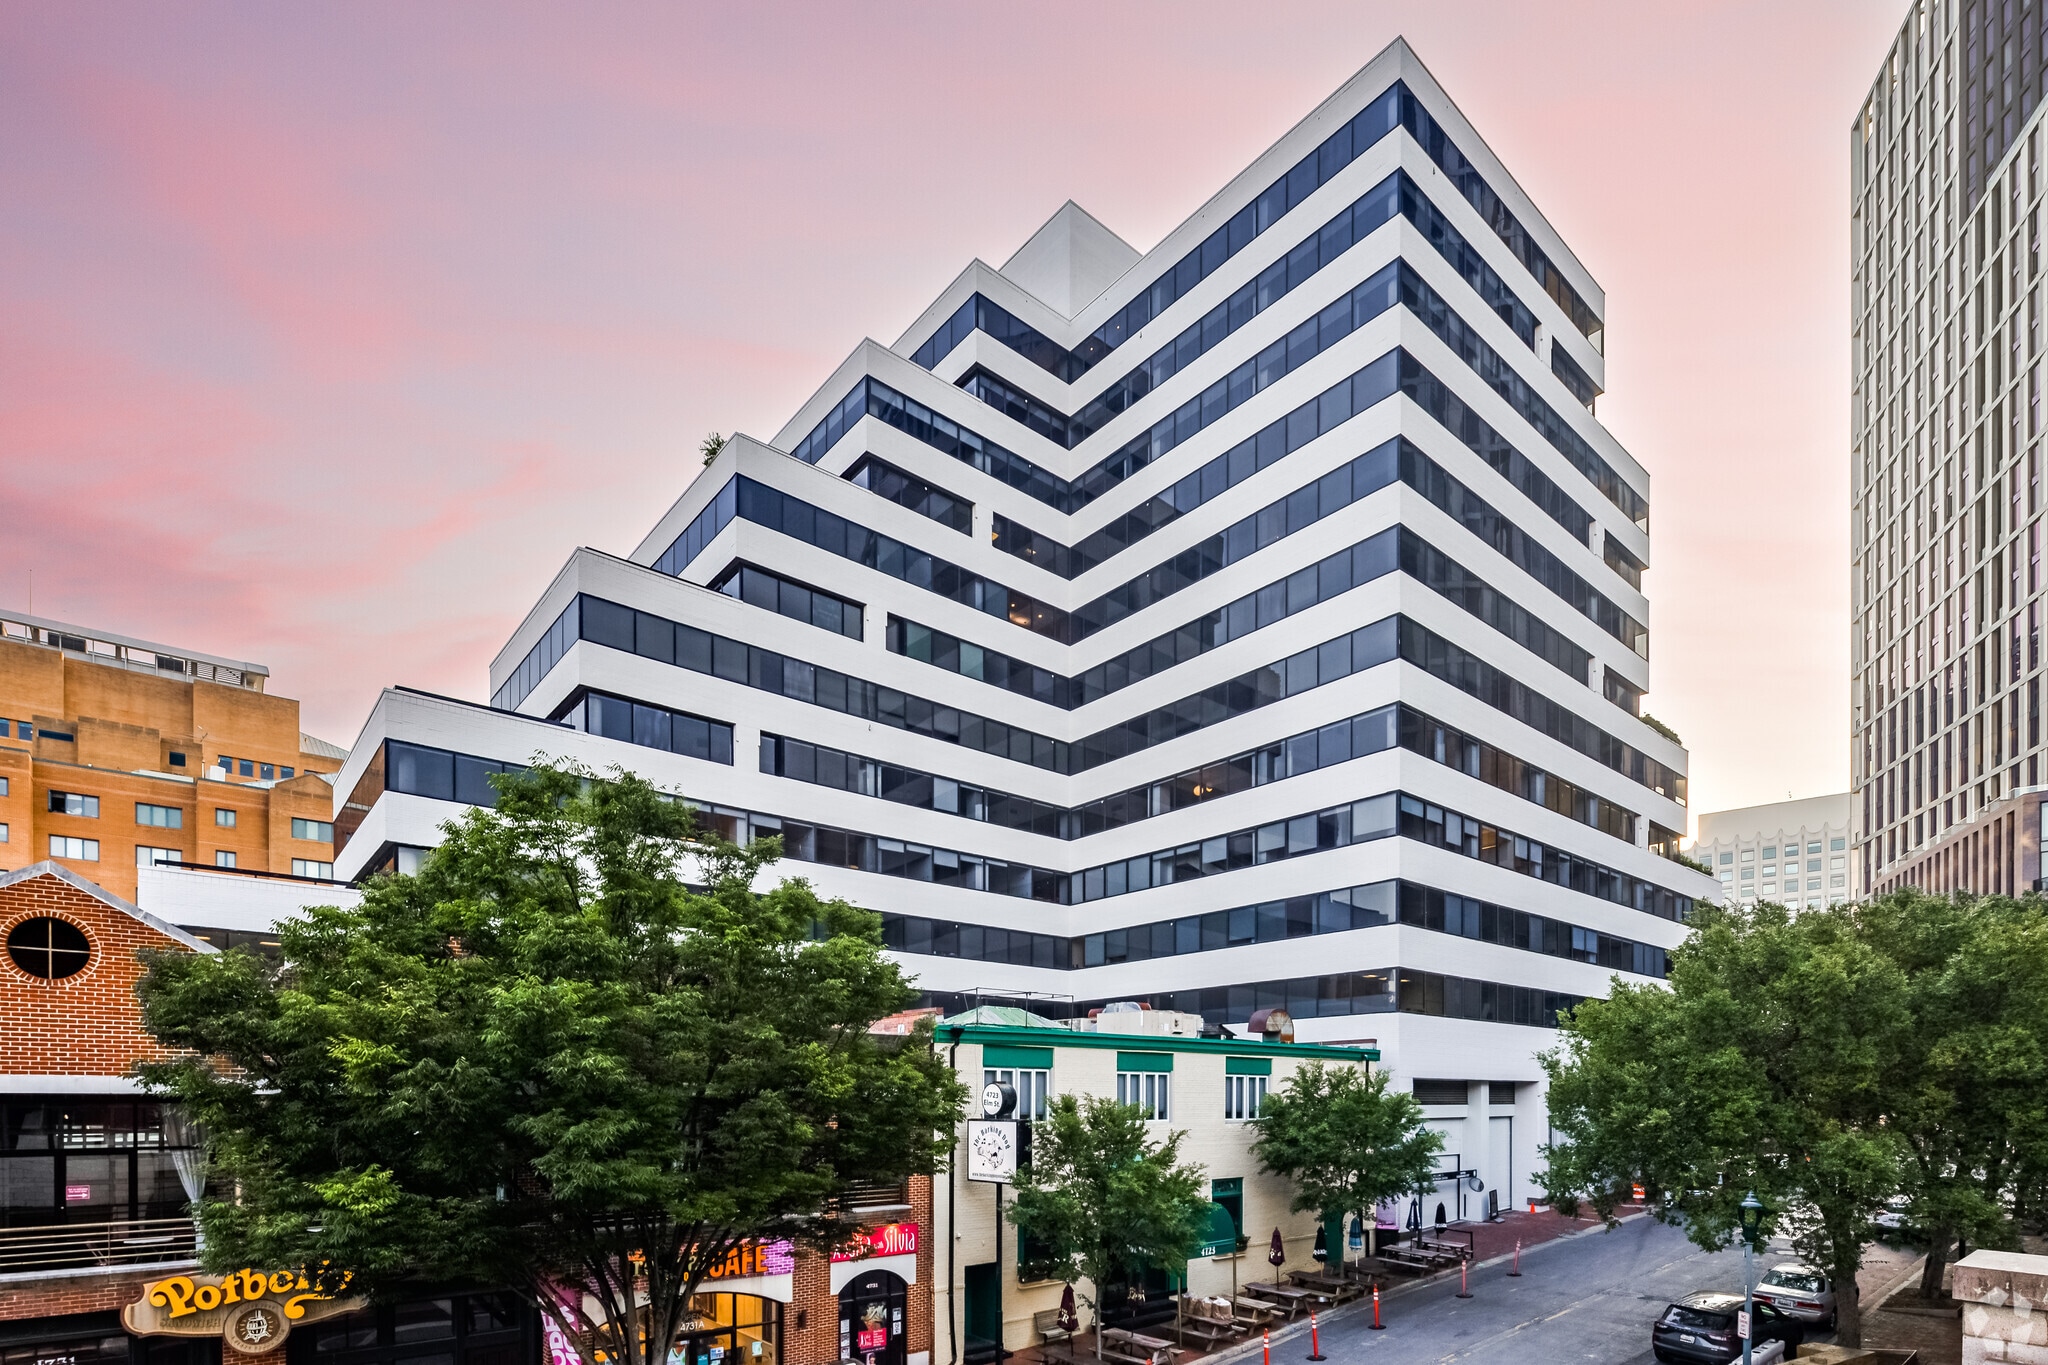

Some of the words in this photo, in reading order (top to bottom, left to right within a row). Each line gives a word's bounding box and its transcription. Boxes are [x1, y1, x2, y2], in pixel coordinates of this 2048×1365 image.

[986, 1091, 999, 1099] 4723
[884, 1227, 915, 1254] Silvia
[1201, 1246, 1216, 1256] 4723
[679, 1320, 705, 1332] 4731A
